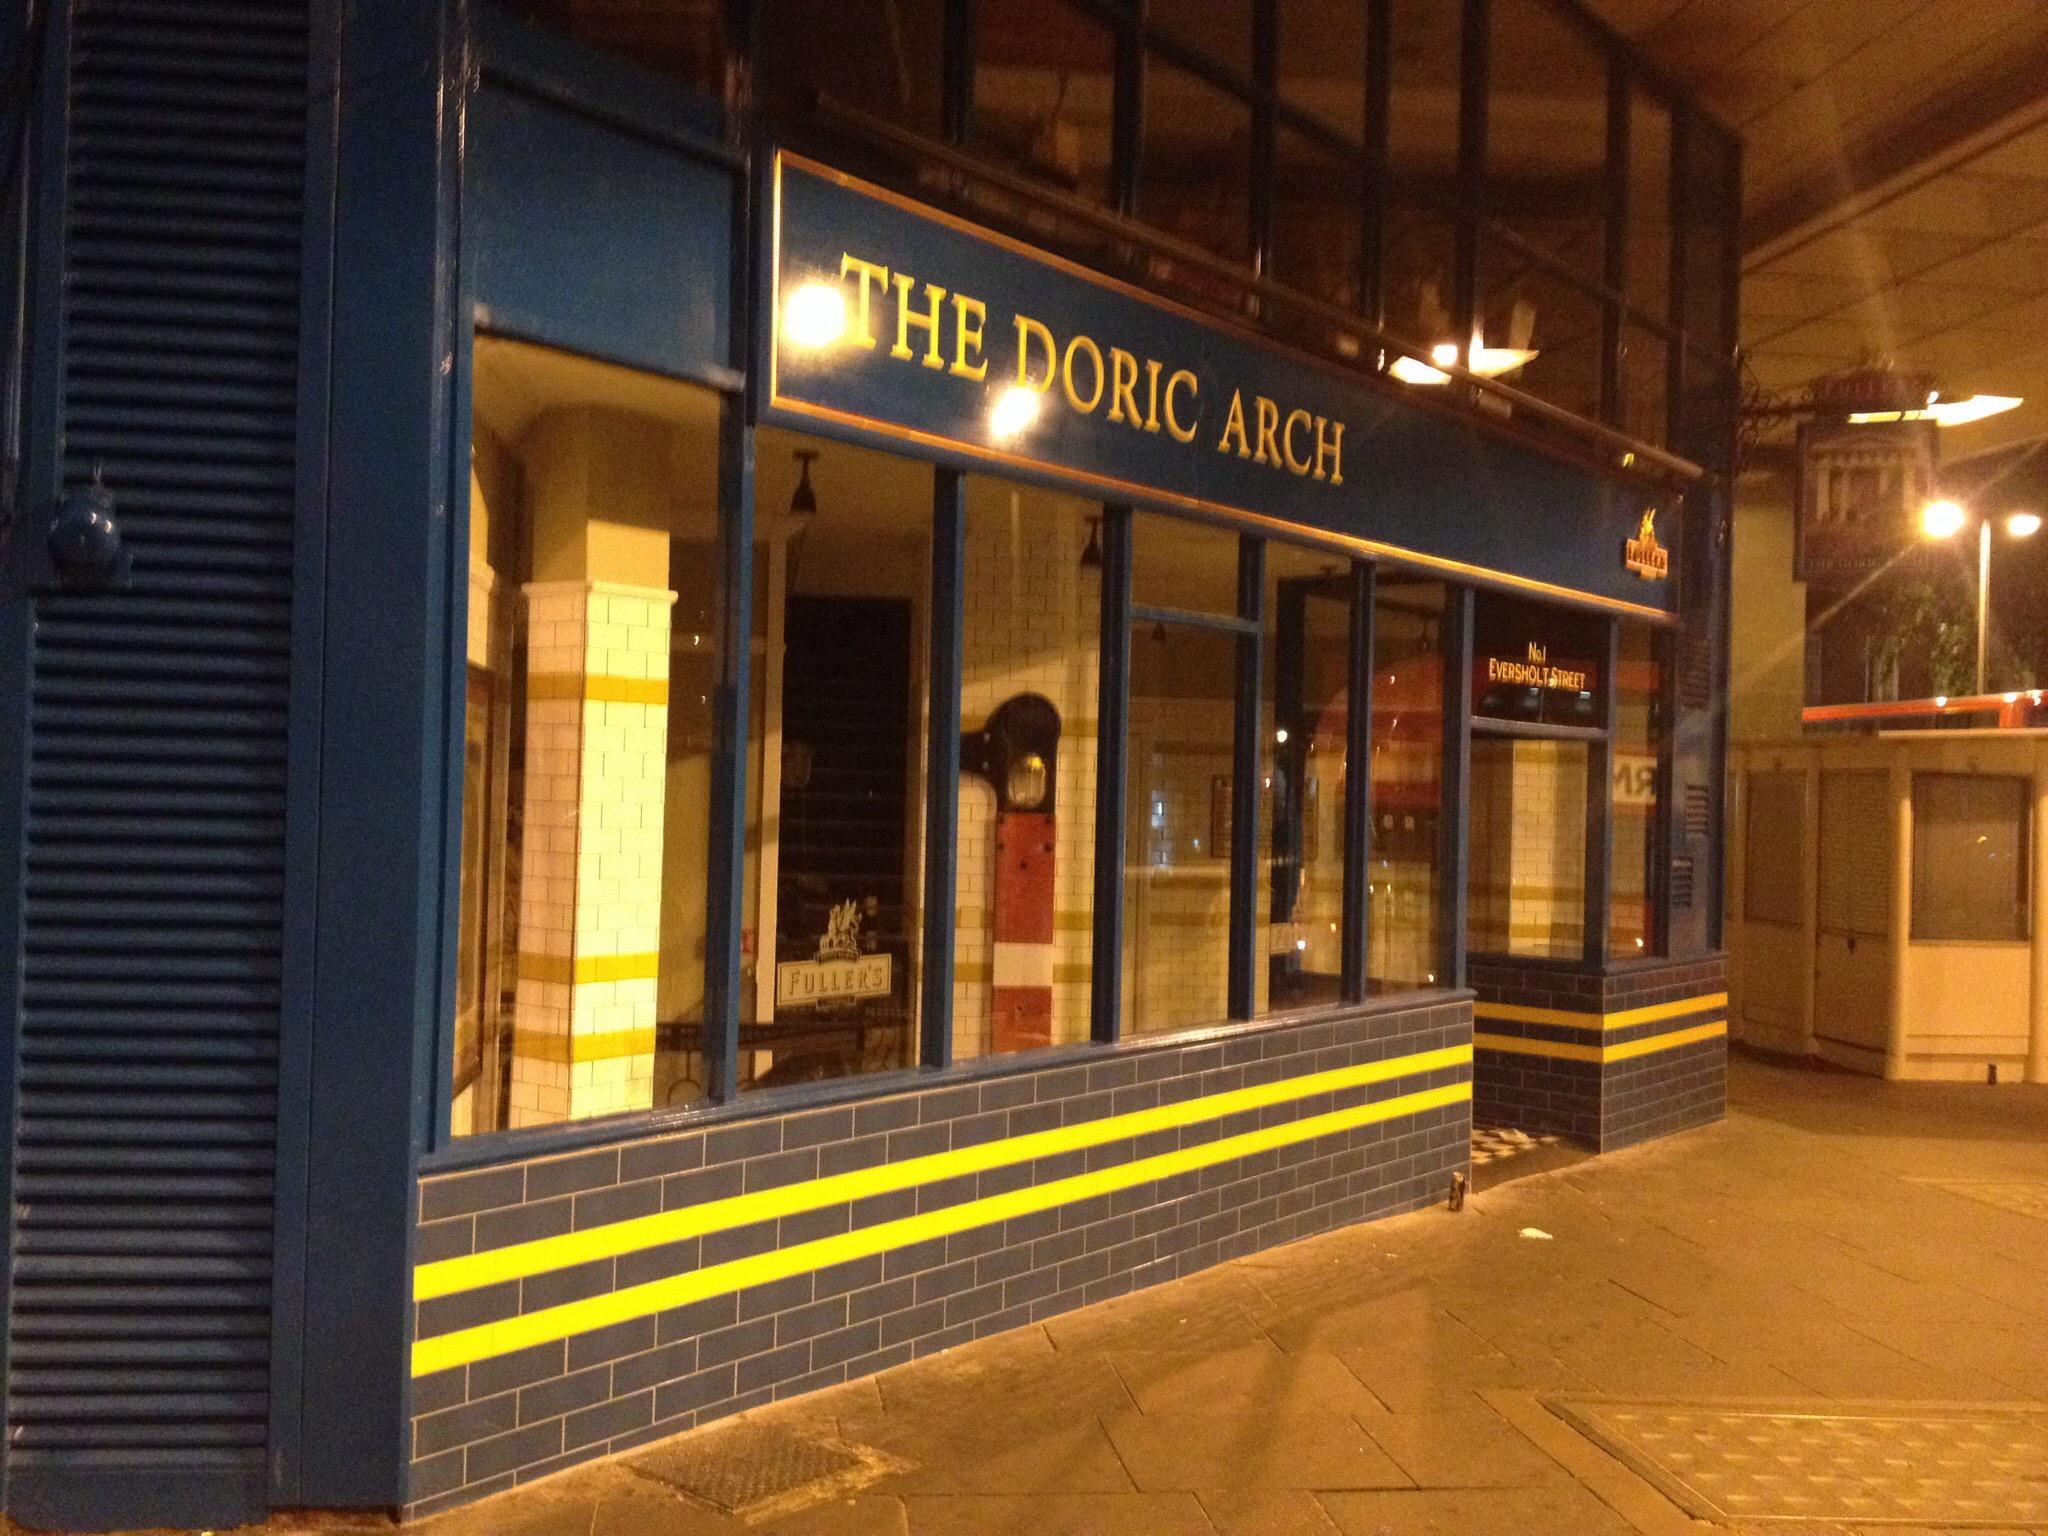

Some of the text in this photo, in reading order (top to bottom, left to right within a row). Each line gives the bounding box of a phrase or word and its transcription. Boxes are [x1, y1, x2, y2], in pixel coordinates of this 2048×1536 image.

[840, 251, 1345, 485] THE DORIC ARCH
[1489, 657, 1585, 691] EVERSHOLT STREET
[789, 964, 883, 996] FULLER'S
